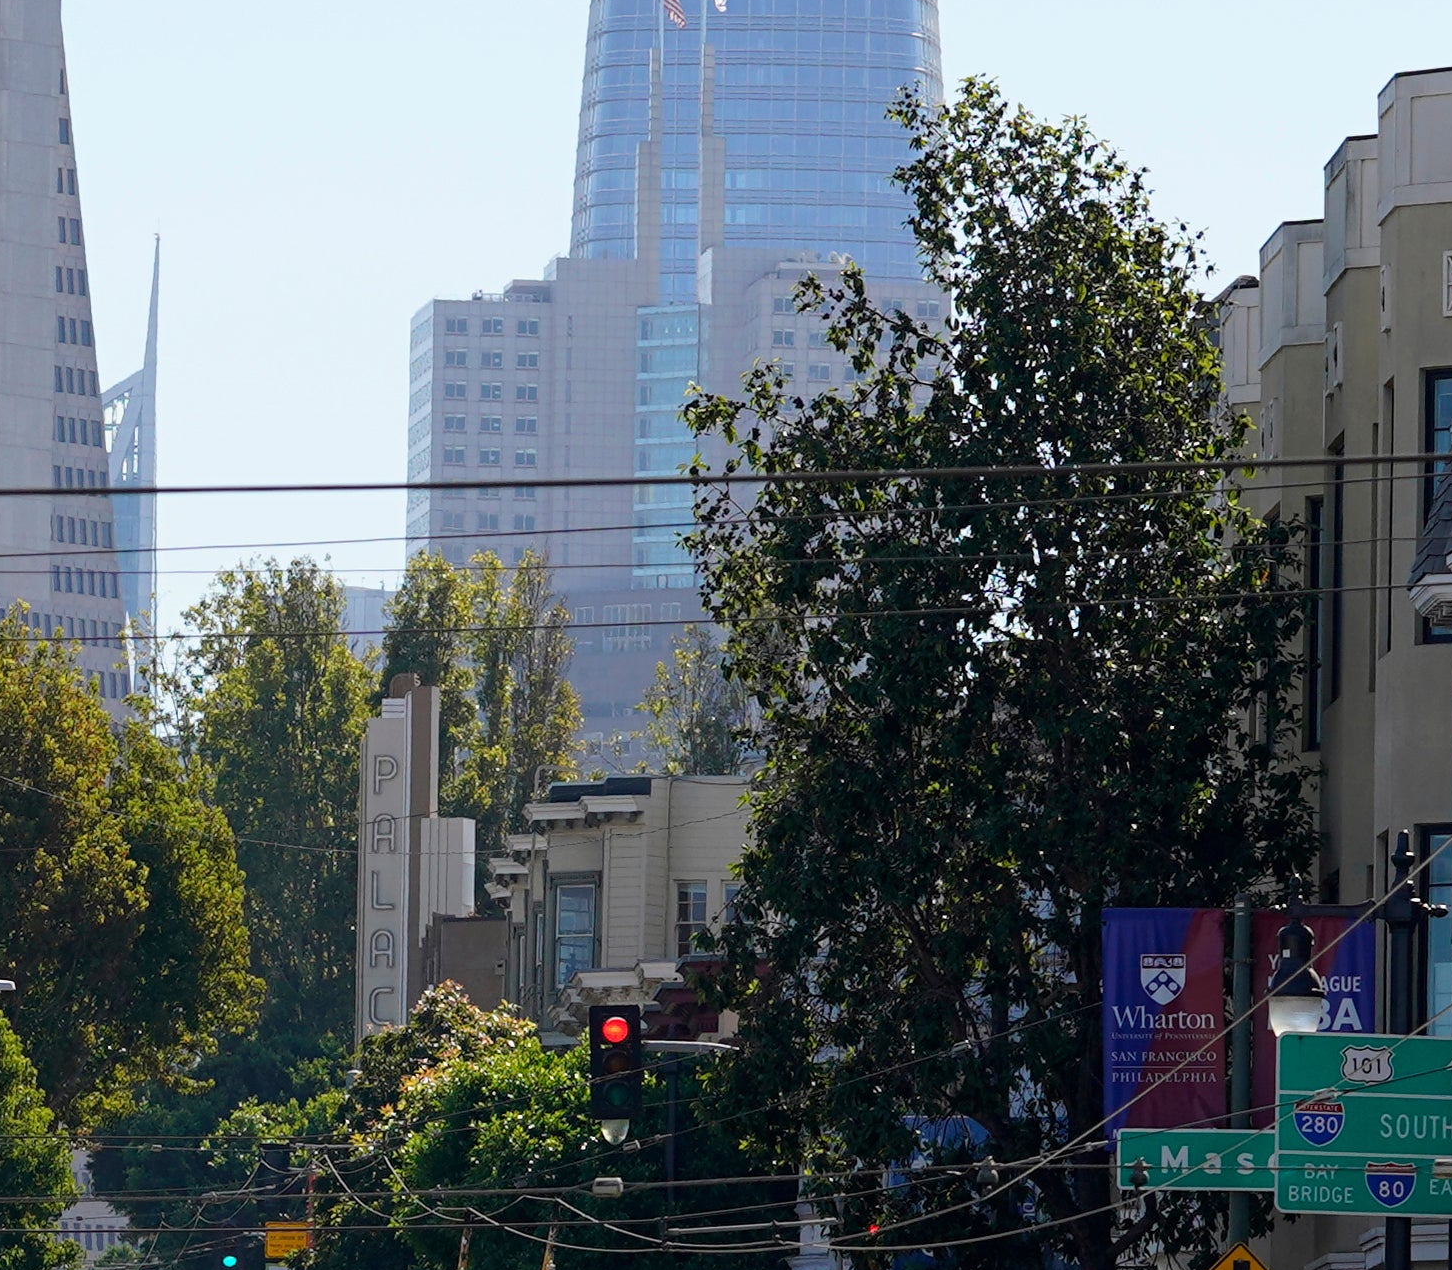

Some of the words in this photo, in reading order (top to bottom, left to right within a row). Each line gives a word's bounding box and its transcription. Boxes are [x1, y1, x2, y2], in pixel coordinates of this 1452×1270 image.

[368, 752, 398, 1027] PALAC
[1112, 1005, 1216, 1030] Wharton
[1112, 1051, 1137, 1062] SAN
[1142, 1051, 1217, 1062] FRANCISCO
[1353, 1057, 1382, 1074] 101
[1112, 1072, 1217, 1083] PHILADELPHIA
[1301, 1116, 1338, 1134] 280
[1303, 1162, 1339, 1180] BAY
[1378, 1181, 1404, 1198] 80
[1288, 1185, 1354, 1204] BRIDGE
